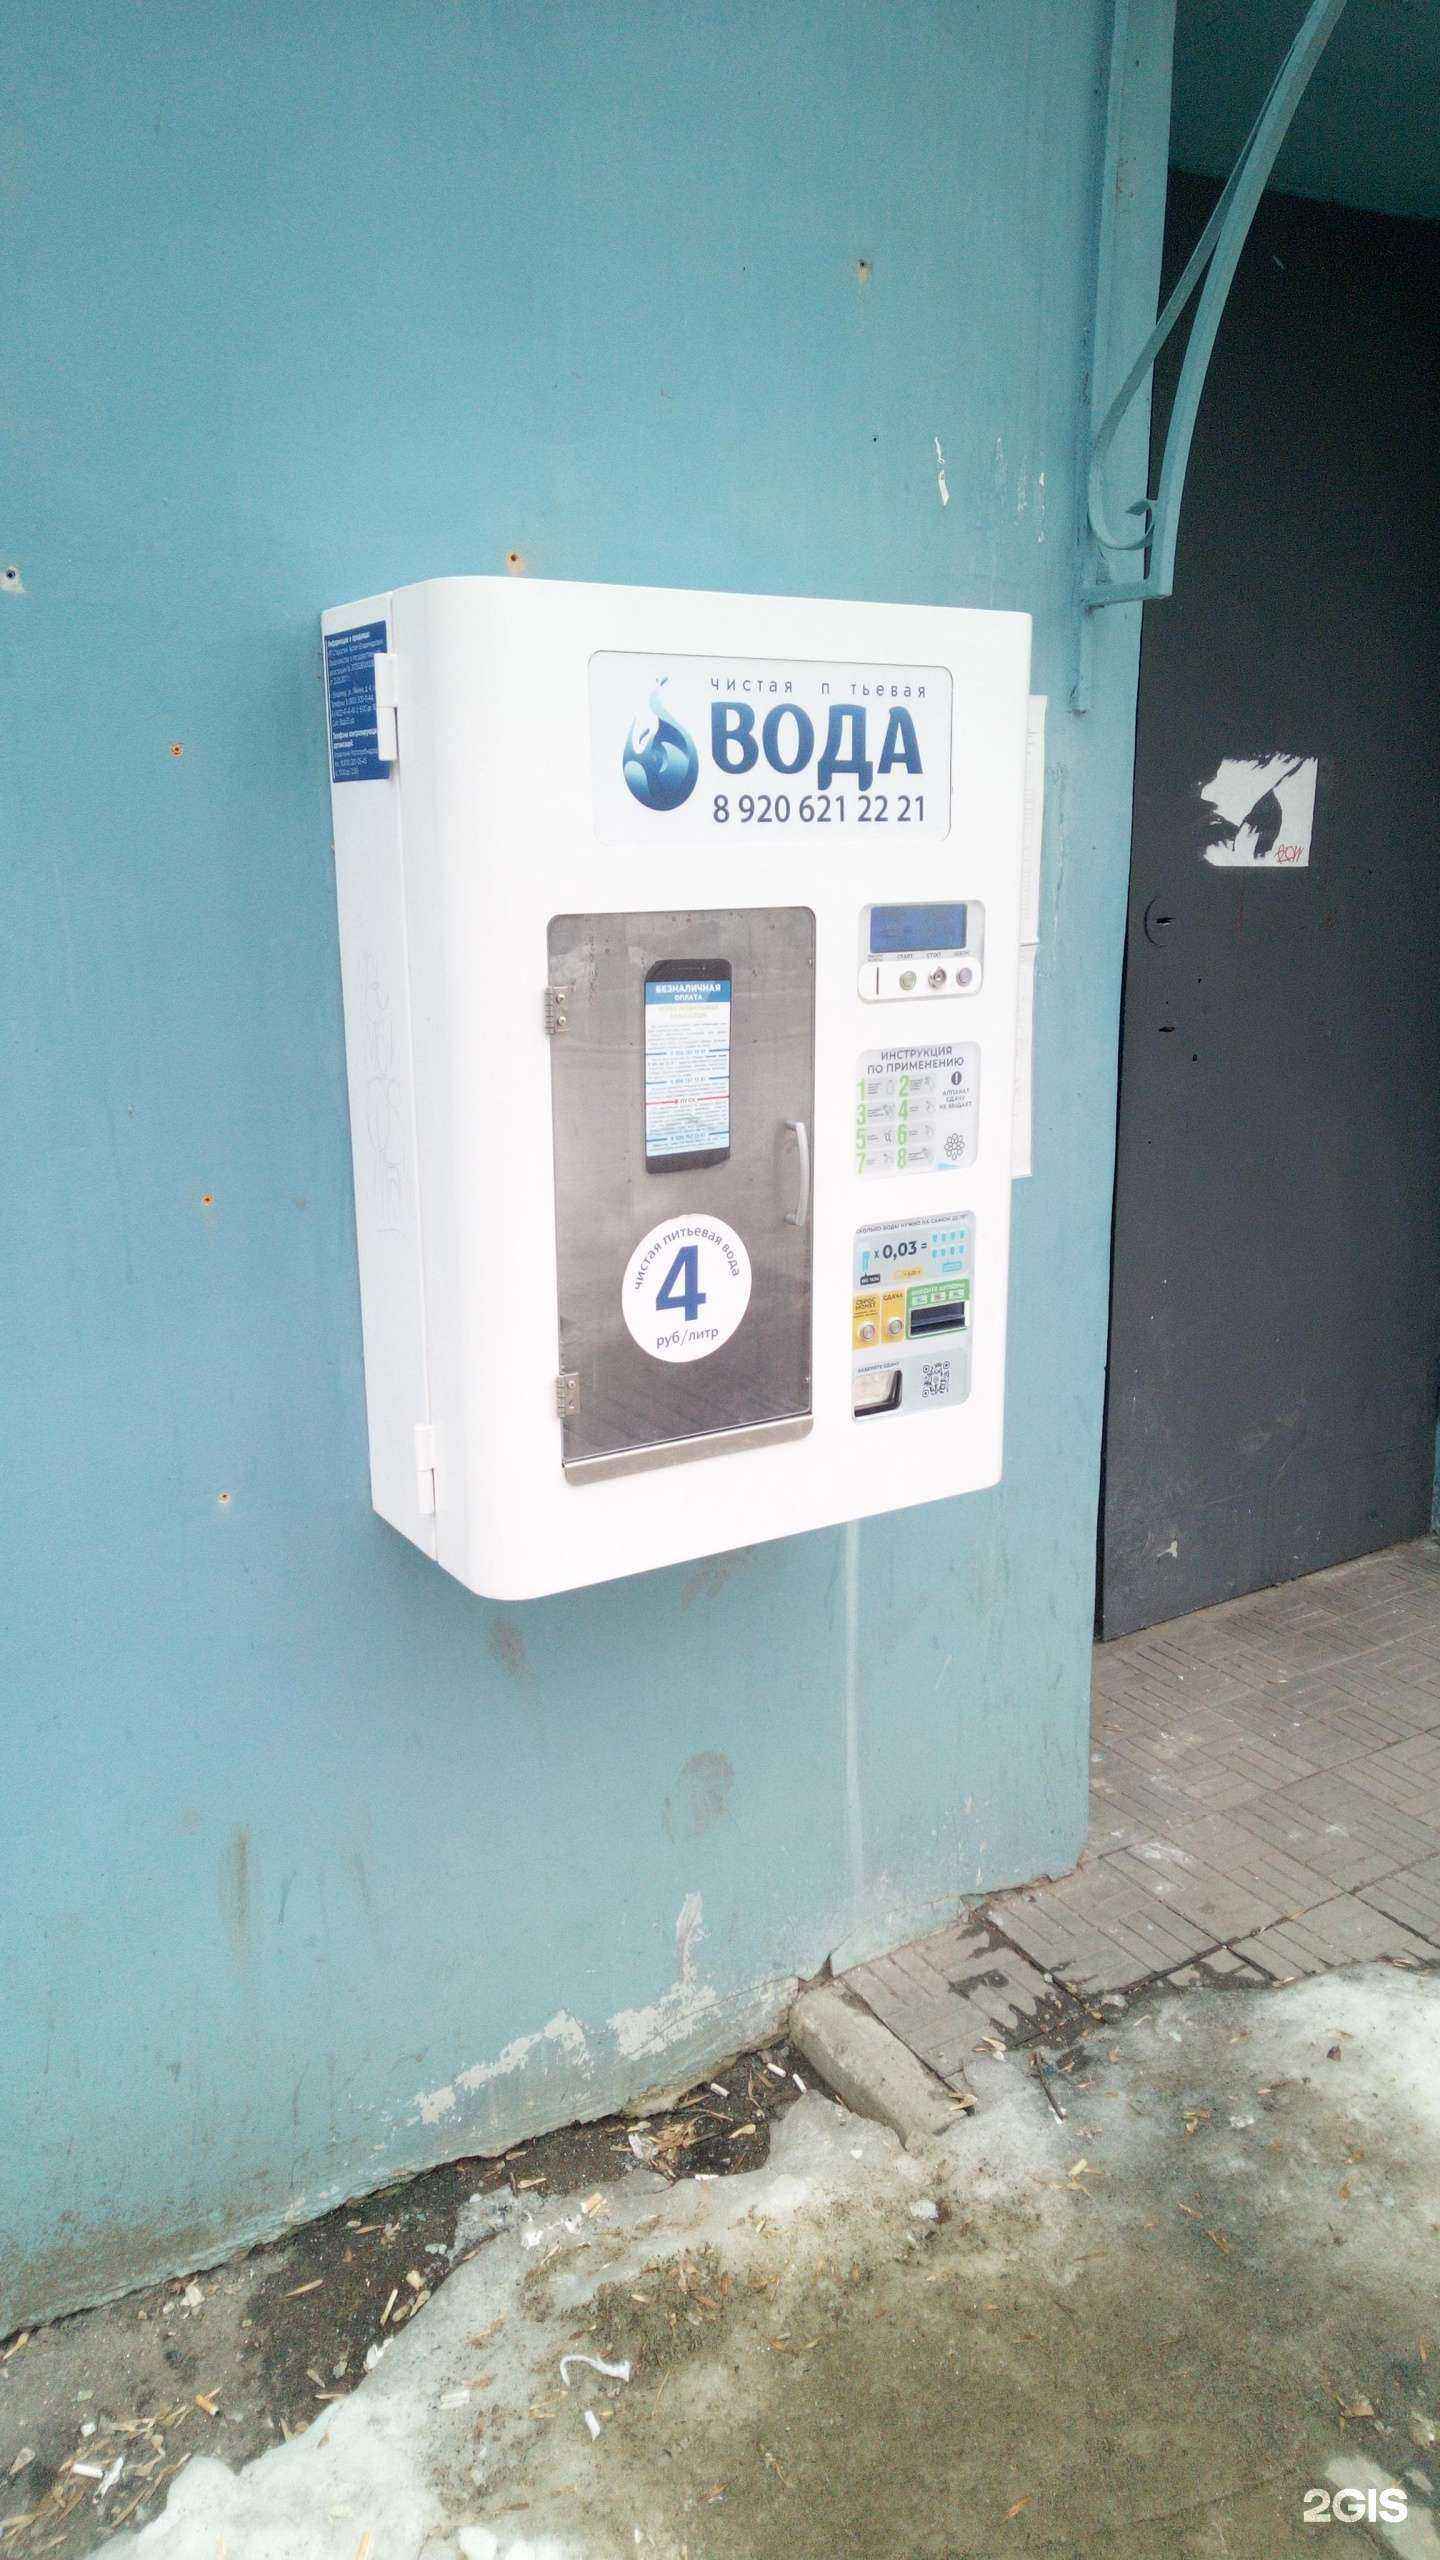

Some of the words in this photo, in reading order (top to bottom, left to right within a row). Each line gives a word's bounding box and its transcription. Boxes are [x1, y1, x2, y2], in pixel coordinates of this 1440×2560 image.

[710, 677, 793, 694] чистая
[711, 701, 924, 791] ВОДА
[713, 794, 729, 823] 8
[738, 794, 791, 823] 920
[799, 795, 845, 823] 621
[858, 795, 888, 823] 22
[897, 795, 925, 823] 21
[655, 983, 721, 993] БЕЗНАЛИЧНАЯ
[881, 1046, 953, 1061] ИНСТРУКЦИЯ
[867, 1064, 883, 1075] ПО
[886, 1056, 965, 1073] ПРИМЕНЕНИЮ
[899, 1075, 910, 1098] 2
[898, 1099, 908, 1121] 4
[897, 1123, 907, 1146] 6
[897, 1148, 907, 1169] 8
[634, 1243, 662, 1290] чистая
[663, 1227, 723, 1246] питьевая
[722, 1244, 740, 1277] вода
[882, 1240, 917, 1261] 0,03
[656, 1245, 706, 1322] 4
[656, 1328, 719, 1348] руб/литр
